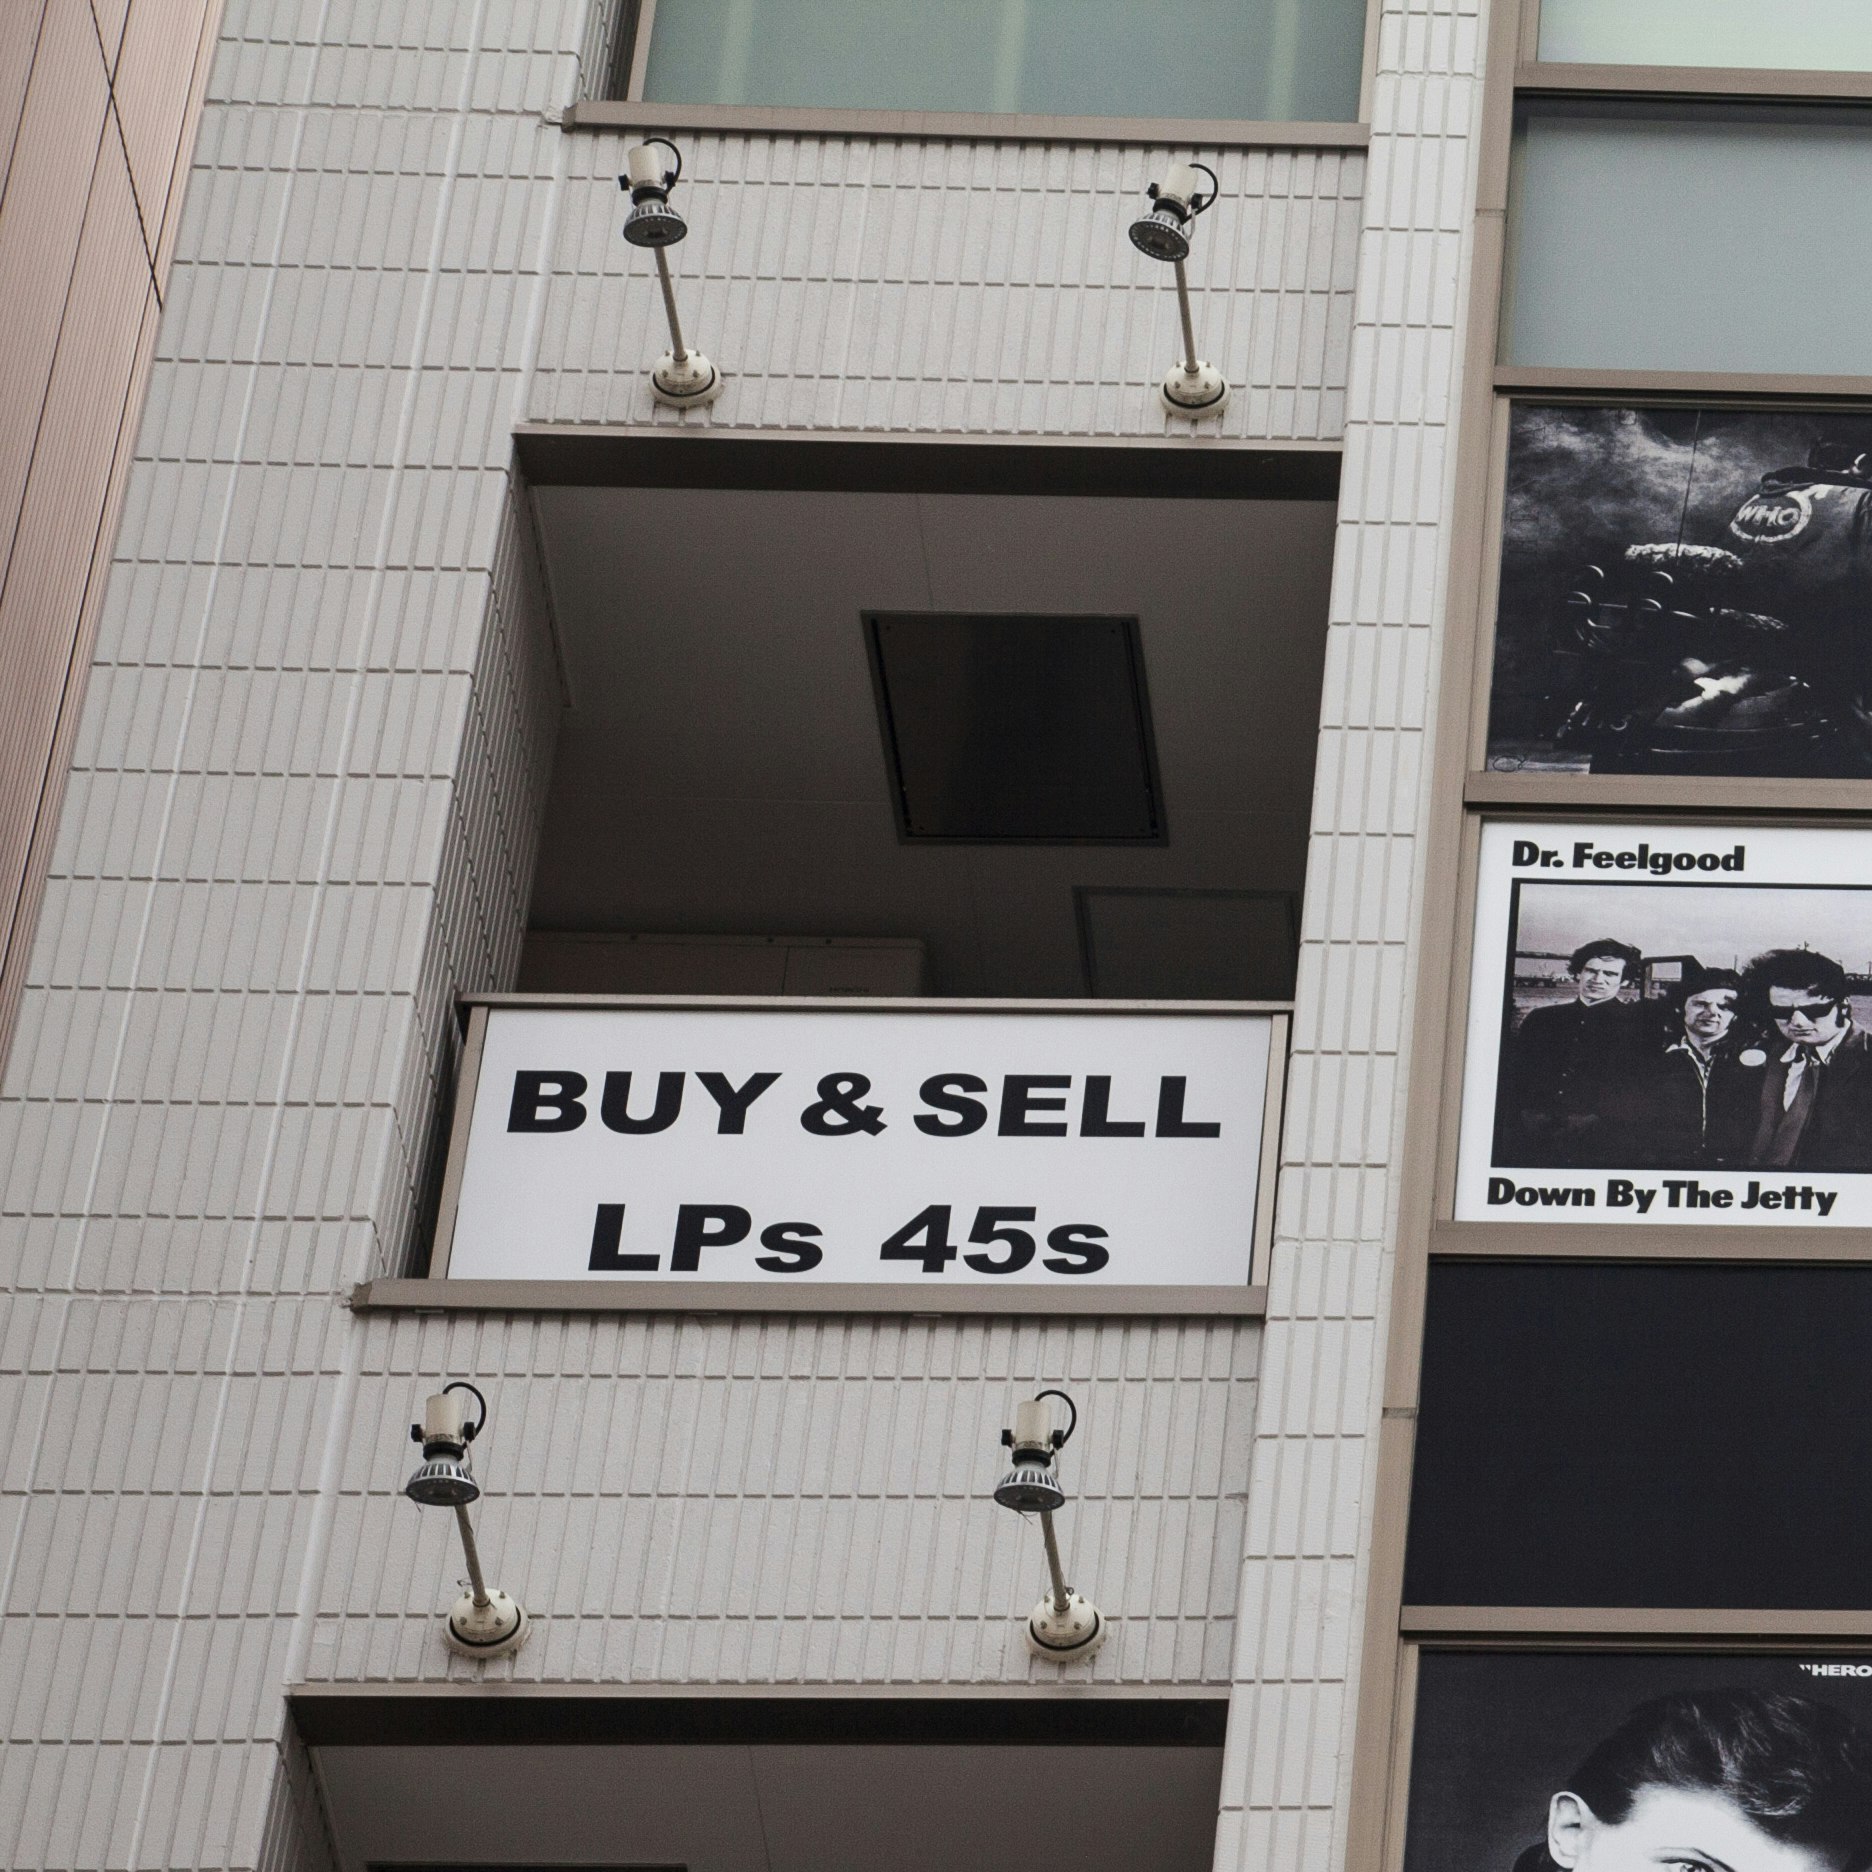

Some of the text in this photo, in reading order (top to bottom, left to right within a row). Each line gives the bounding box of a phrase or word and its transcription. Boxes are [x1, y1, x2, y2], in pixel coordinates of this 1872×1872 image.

[1736, 505, 1801, 527] WHO
[1512, 841, 1745, 875] Dr. Feelgood
[507, 1071, 1220, 1138] BUY & SELL
[1487, 1177, 1837, 1216] Down By The Jetty
[588, 1204, 1109, 1274] LPs 45s
